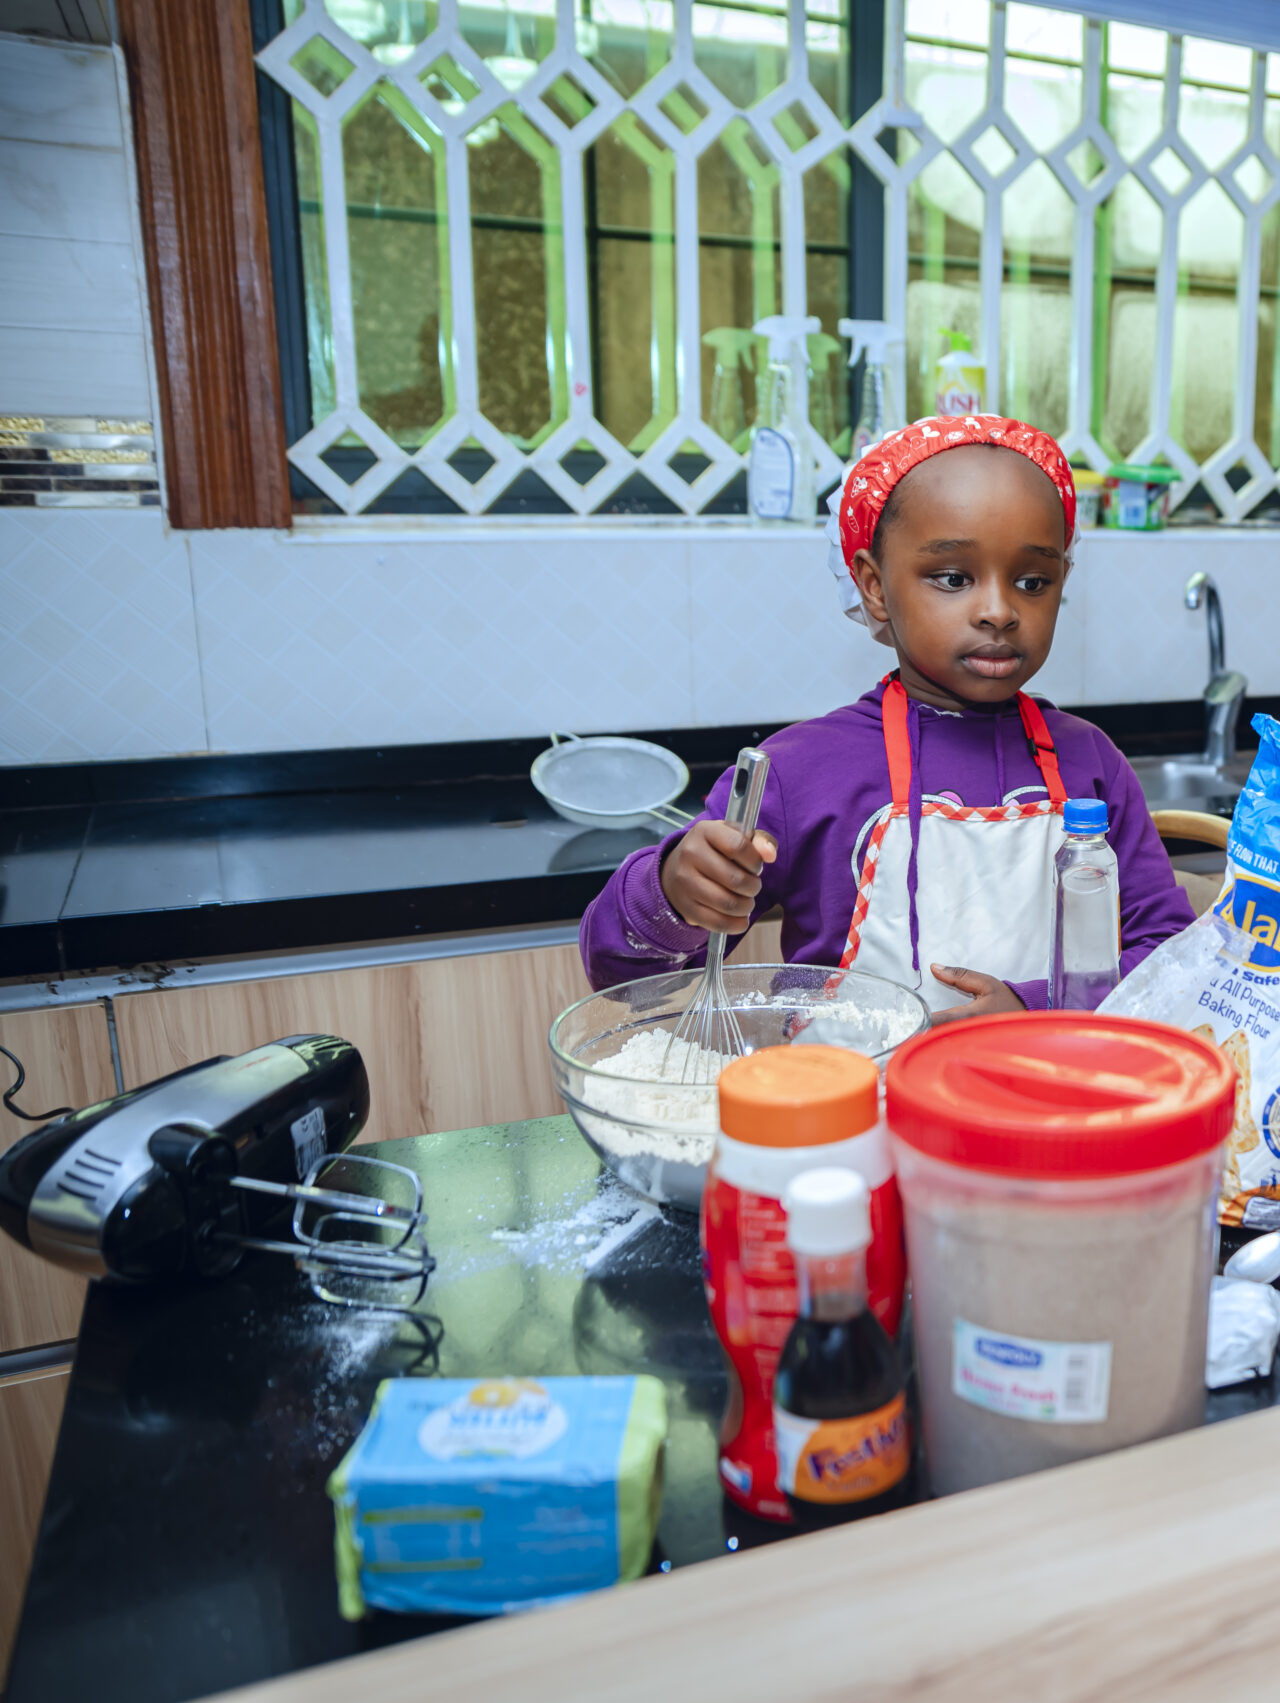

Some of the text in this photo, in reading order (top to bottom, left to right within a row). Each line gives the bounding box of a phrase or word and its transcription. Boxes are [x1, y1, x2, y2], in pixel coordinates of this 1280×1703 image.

[1253, 853, 1279, 874] THAT
[1198, 990, 1243, 1029] Baking
[1244, 1013, 1271, 1040] Flour
[1219, 978, 1280, 1022] All Purpose
